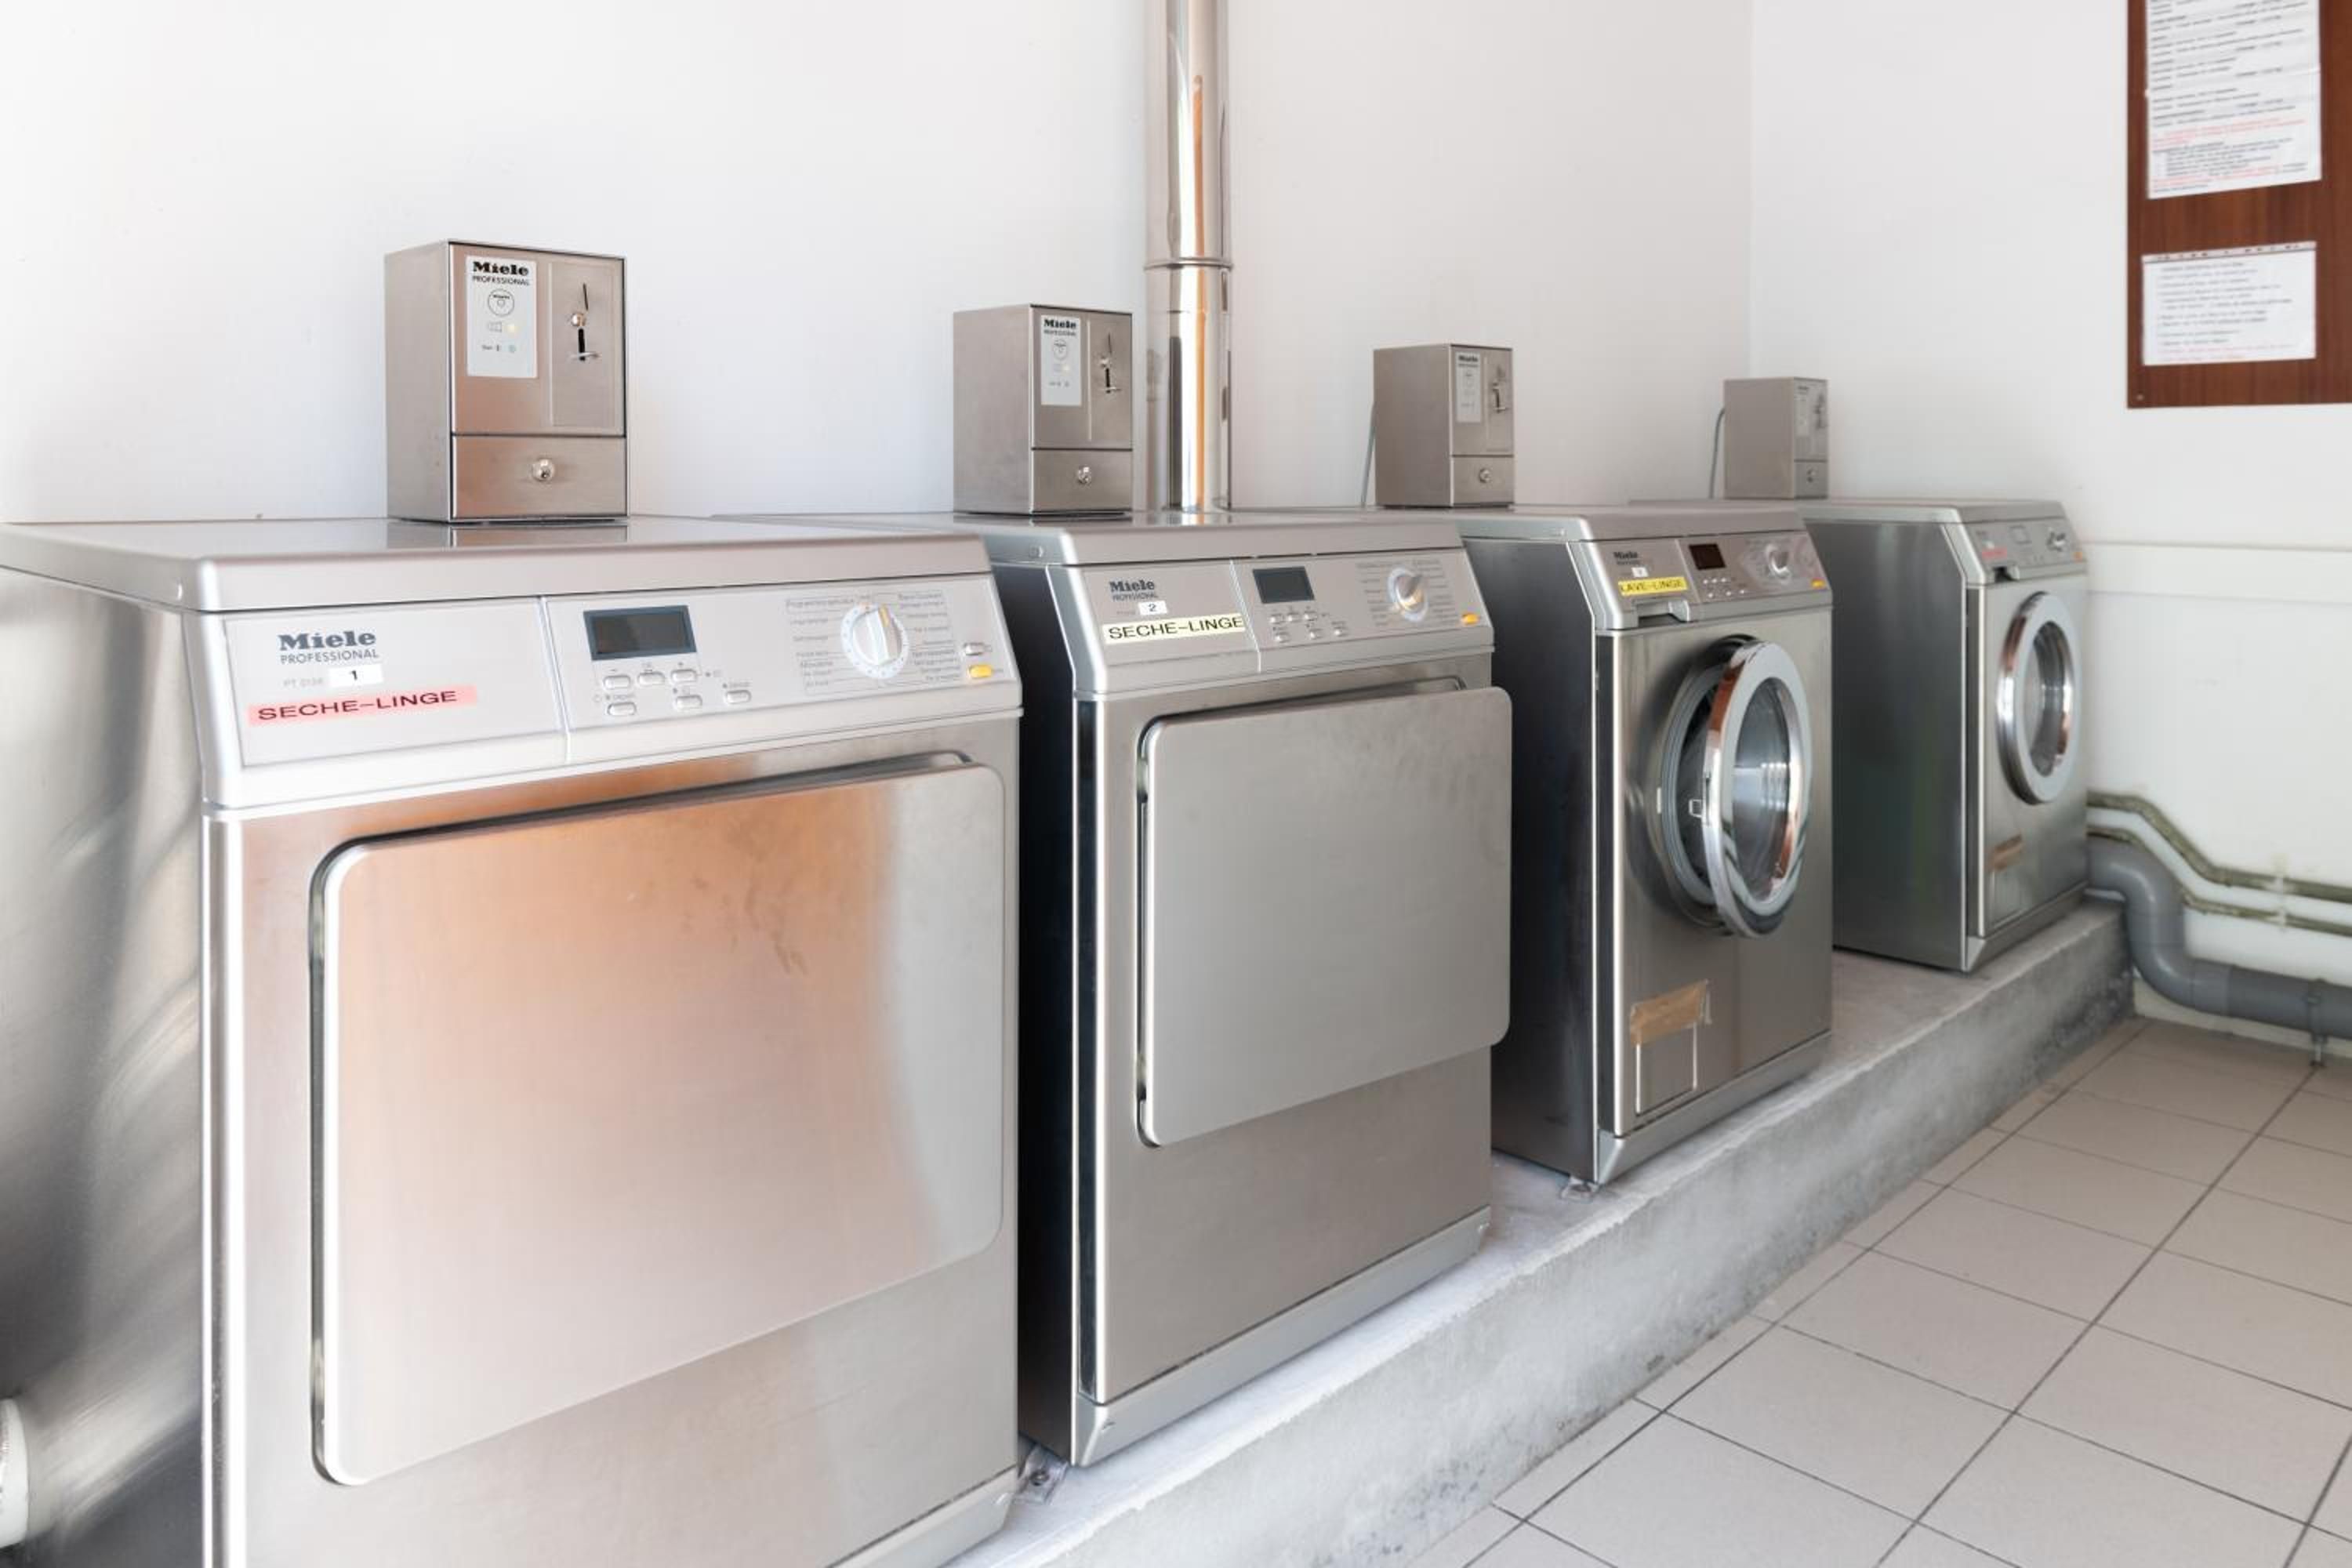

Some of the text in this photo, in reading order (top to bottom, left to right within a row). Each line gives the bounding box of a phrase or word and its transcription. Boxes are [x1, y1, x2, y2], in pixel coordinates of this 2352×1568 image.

[473, 261, 528, 276] Miele
[472, 275, 530, 286] PROFESSIONAL
[1044, 319, 1076, 329] Miele
[1109, 579, 1156, 593] Miele
[1149, 603, 1157, 612] 2
[1108, 615, 1244, 640] SECHE-LINGE
[278, 630, 376, 652] Miele
[280, 648, 379, 665] PROFESSIONAL
[349, 669, 358, 681] 1
[257, 690, 458, 720] SECHE-LINGE
